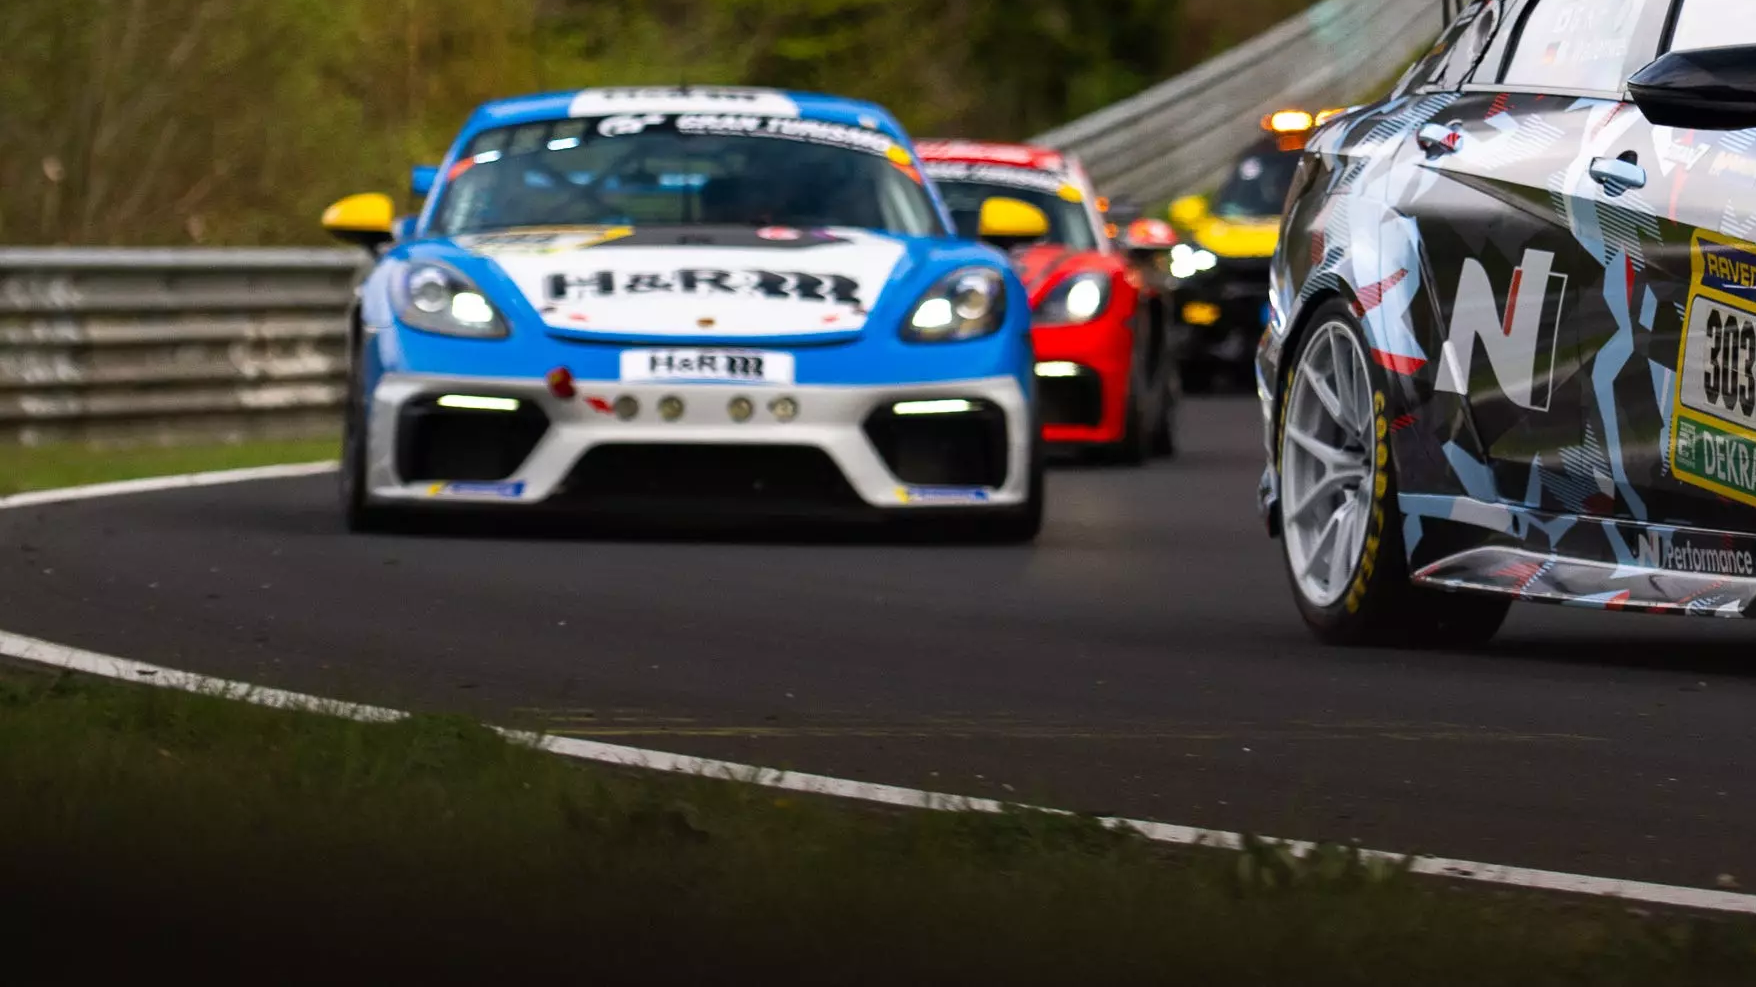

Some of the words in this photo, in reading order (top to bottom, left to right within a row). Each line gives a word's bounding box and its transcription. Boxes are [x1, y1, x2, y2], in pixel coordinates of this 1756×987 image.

[1434, 248, 1568, 412] N
[1703, 308, 1756, 417] 303
[1667, 539, 1753, 575] Performance
